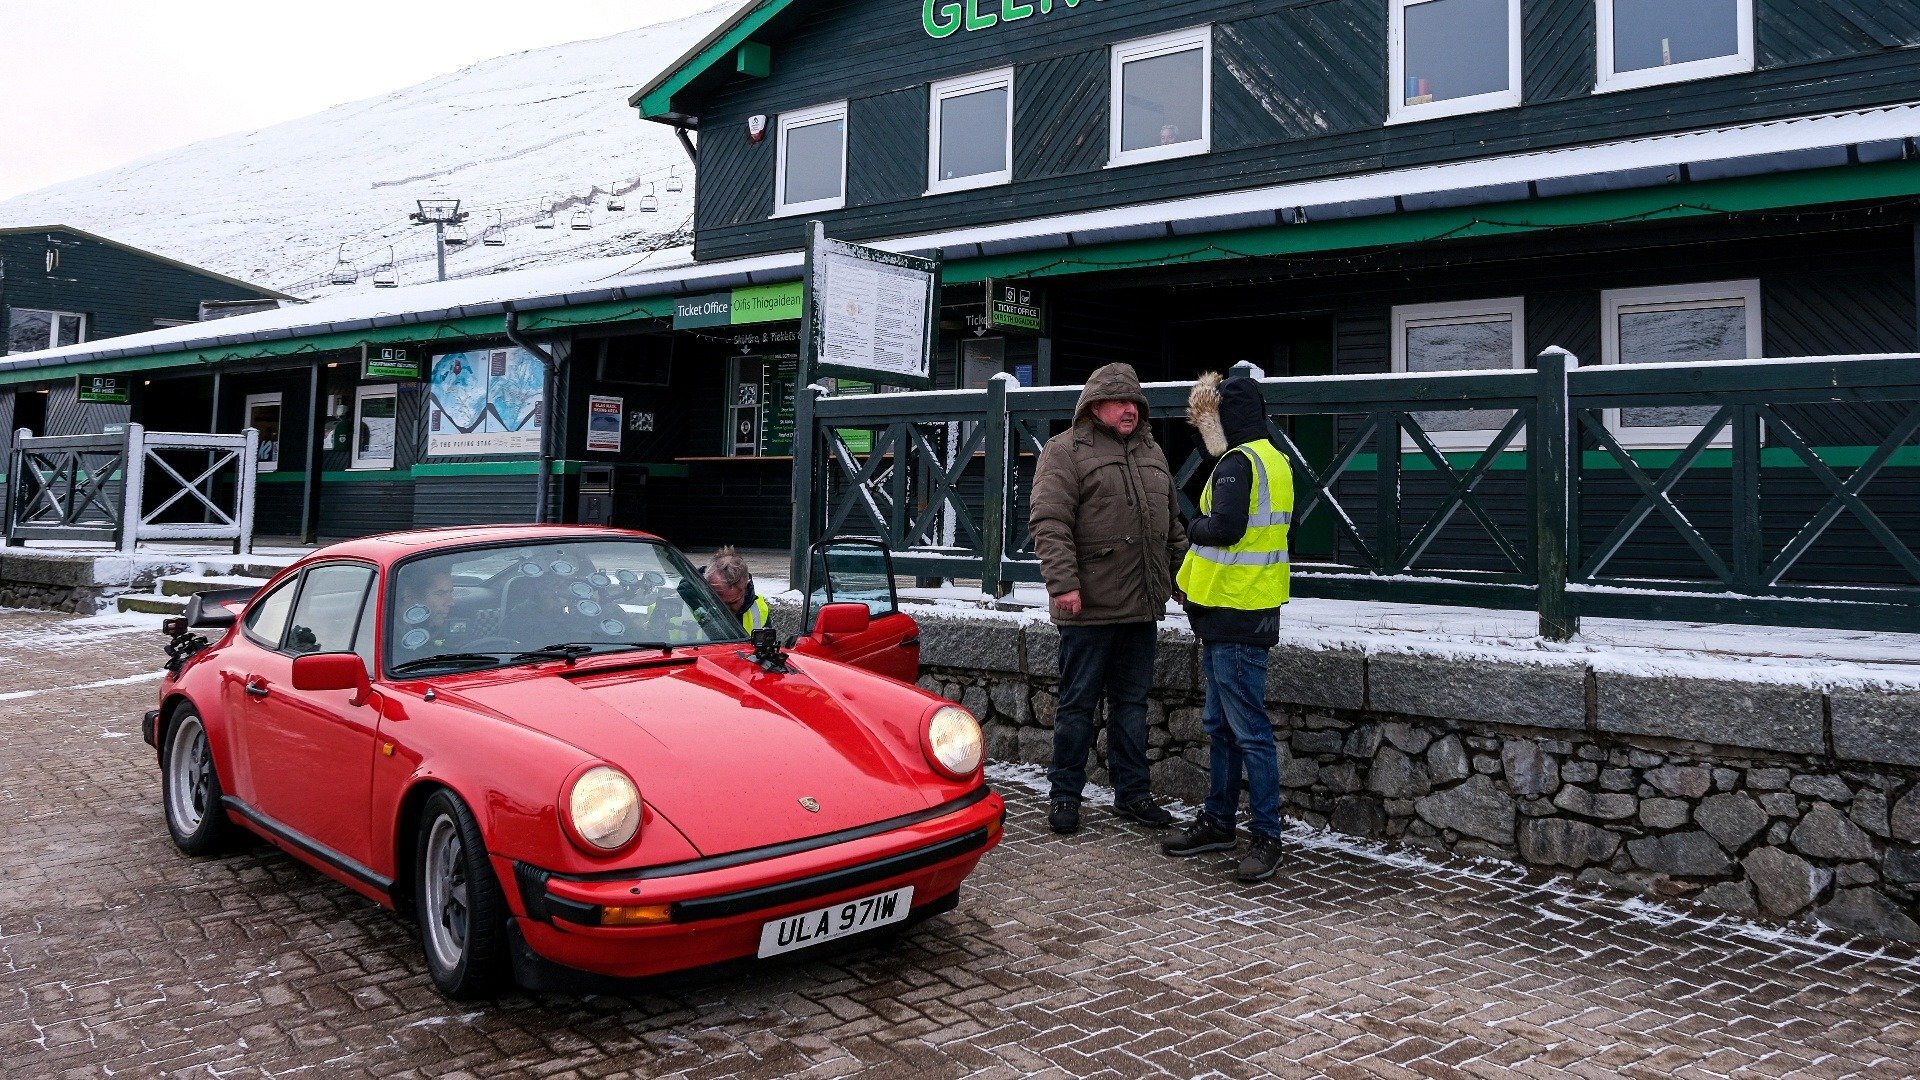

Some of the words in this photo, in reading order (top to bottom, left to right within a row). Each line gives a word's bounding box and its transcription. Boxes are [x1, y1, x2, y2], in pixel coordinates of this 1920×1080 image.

[678, 303, 702, 317] Ticket
[703, 301, 728, 315] Office
[733, 298, 751, 311] Oifis
[752, 294, 801, 310] Thiogaidean
[997, 303, 1017, 314] TICKET
[1017, 307, 1037, 317] OFFICE
[762, 332, 770, 343] &
[770, 330, 796, 342] Tickets
[777, 910, 829, 947] ULA
[839, 892, 899, 931] 971W
